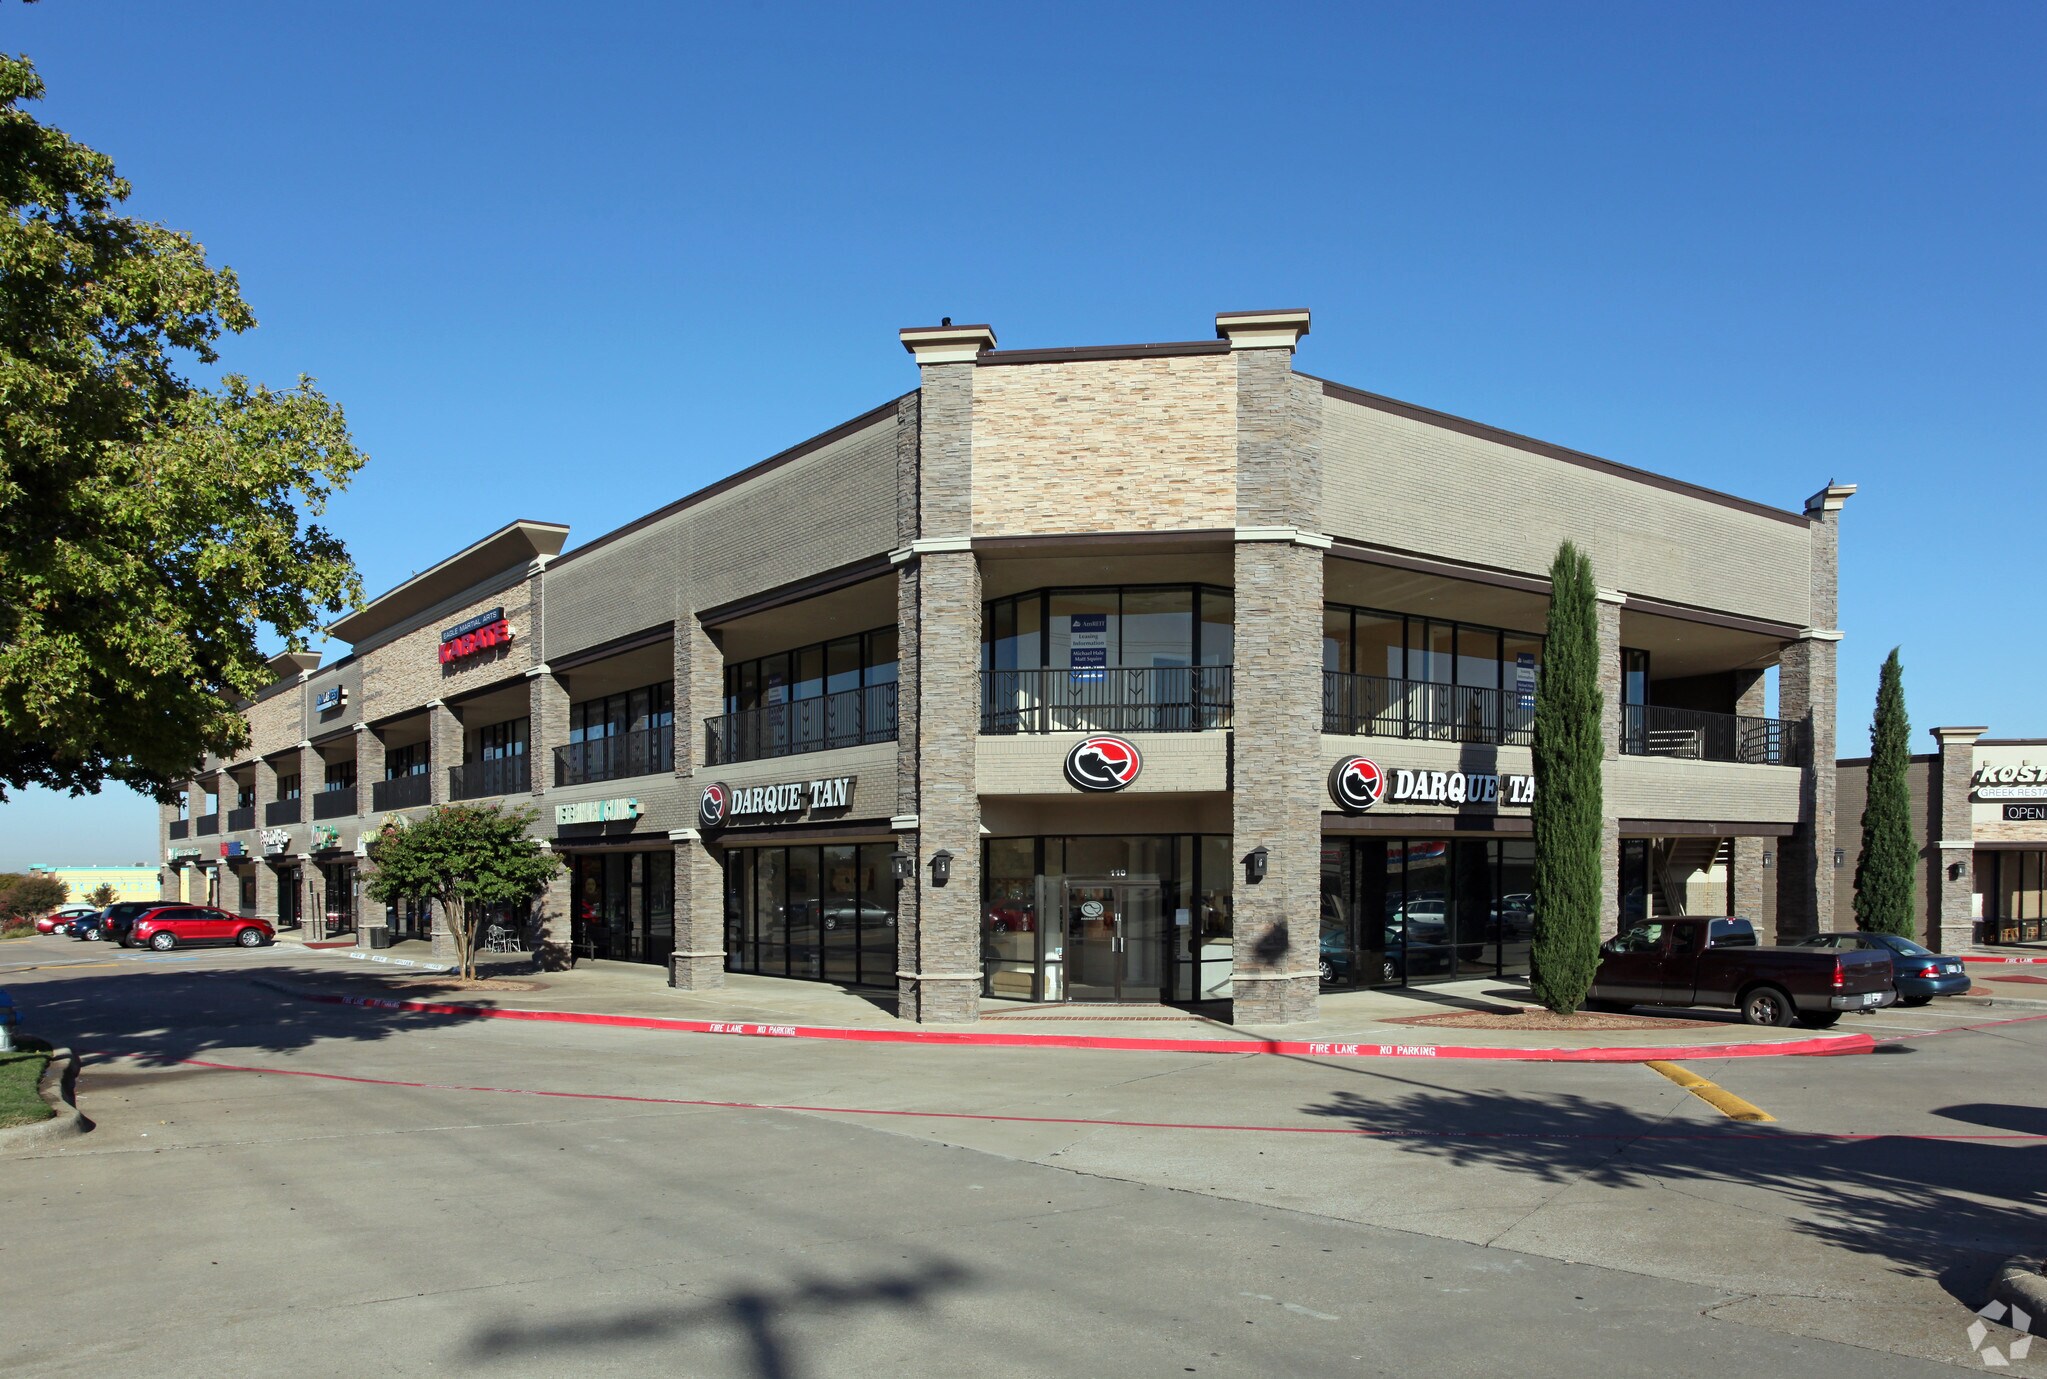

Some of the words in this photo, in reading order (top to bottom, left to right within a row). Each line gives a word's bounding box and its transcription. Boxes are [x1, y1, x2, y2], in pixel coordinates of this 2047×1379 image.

[443, 628, 458, 639] EAGLE
[459, 619, 481, 632] MARTIAL
[482, 611, 497, 622] ARTS
[439, 619, 509, 665] KARATE
[730, 783, 802, 815] DARQUE
[809, 778, 849, 809] TAN
[1394, 769, 1499, 803] DARQUE
[1509, 775, 1535, 803] TA
[1980, 788, 2014, 797] GREEK
[2008, 807, 2045, 819] OPEN
[709, 1023, 725, 1032] FIRE
[726, 1024, 744, 1033] LANE
[756, 1025, 767, 1034] NO
[768, 1026, 796, 1036] PARKING
[1309, 1043, 1331, 1054] FIRE
[1334, 1044, 1358, 1055] LANE
[1380, 1045, 1393, 1055] NO
[1397, 1046, 1436, 1057] PARKING
